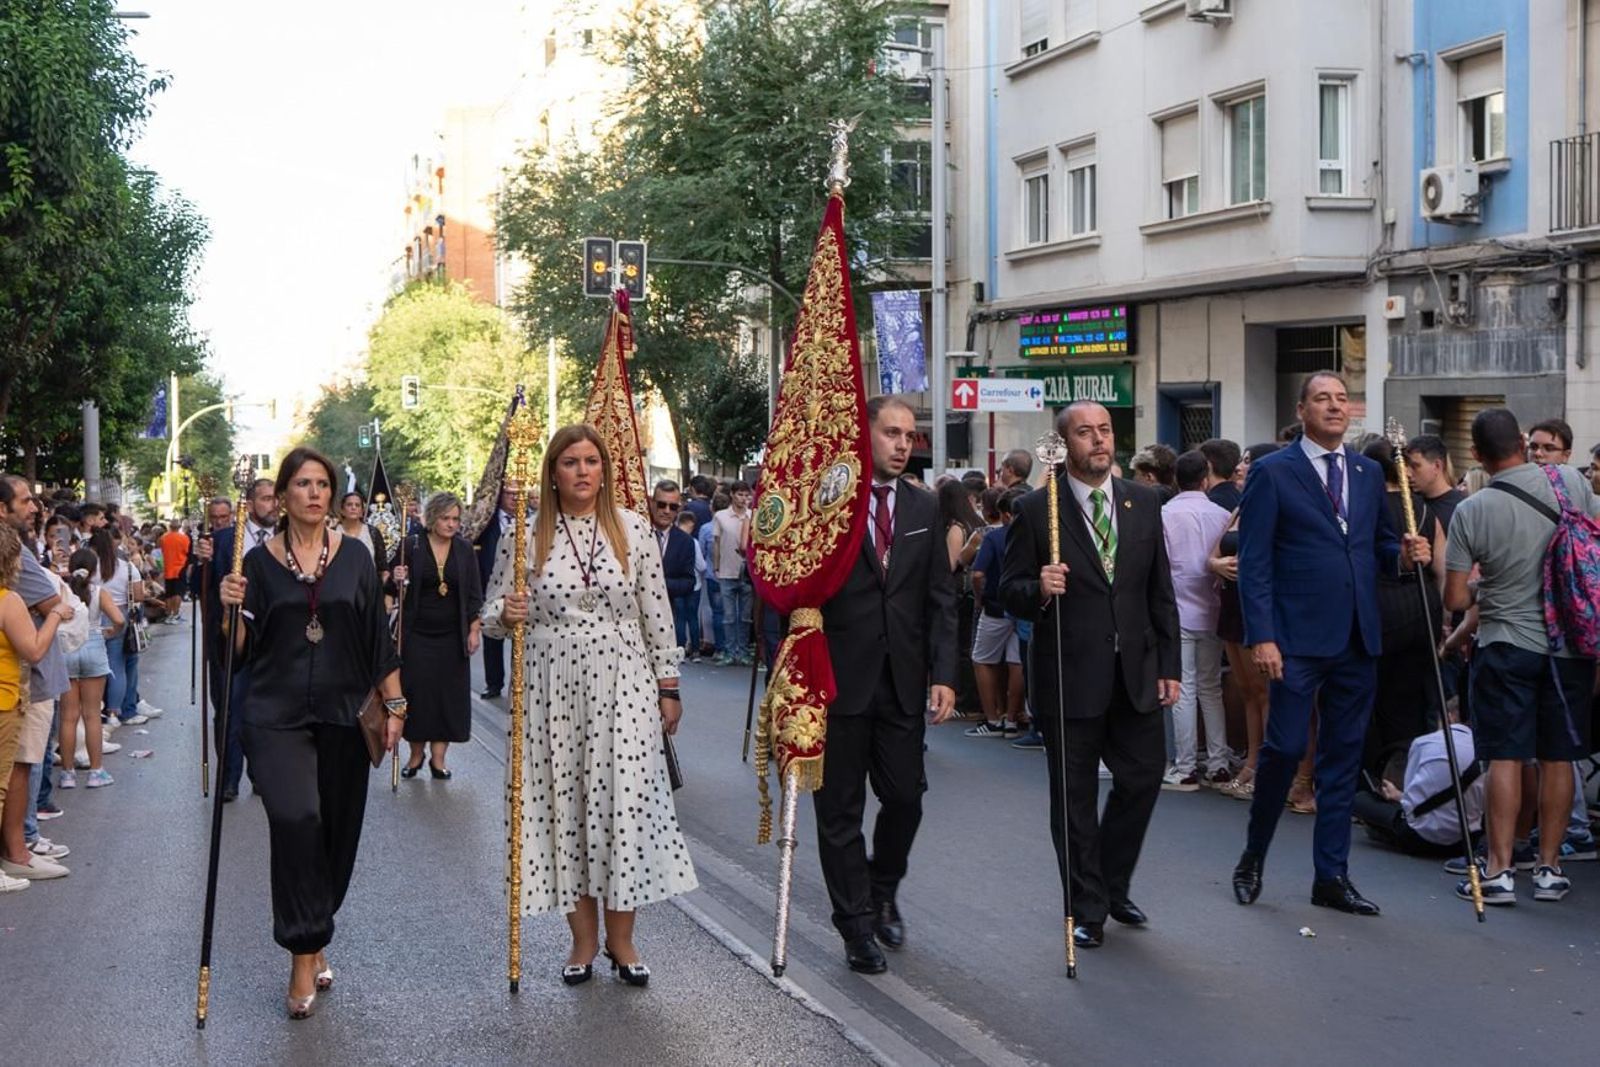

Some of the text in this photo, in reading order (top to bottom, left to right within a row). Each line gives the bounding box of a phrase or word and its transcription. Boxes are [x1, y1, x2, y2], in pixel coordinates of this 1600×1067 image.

[980, 387, 1022, 397] Carrefour
[1044, 375, 1118, 402] CAJA RURAL
